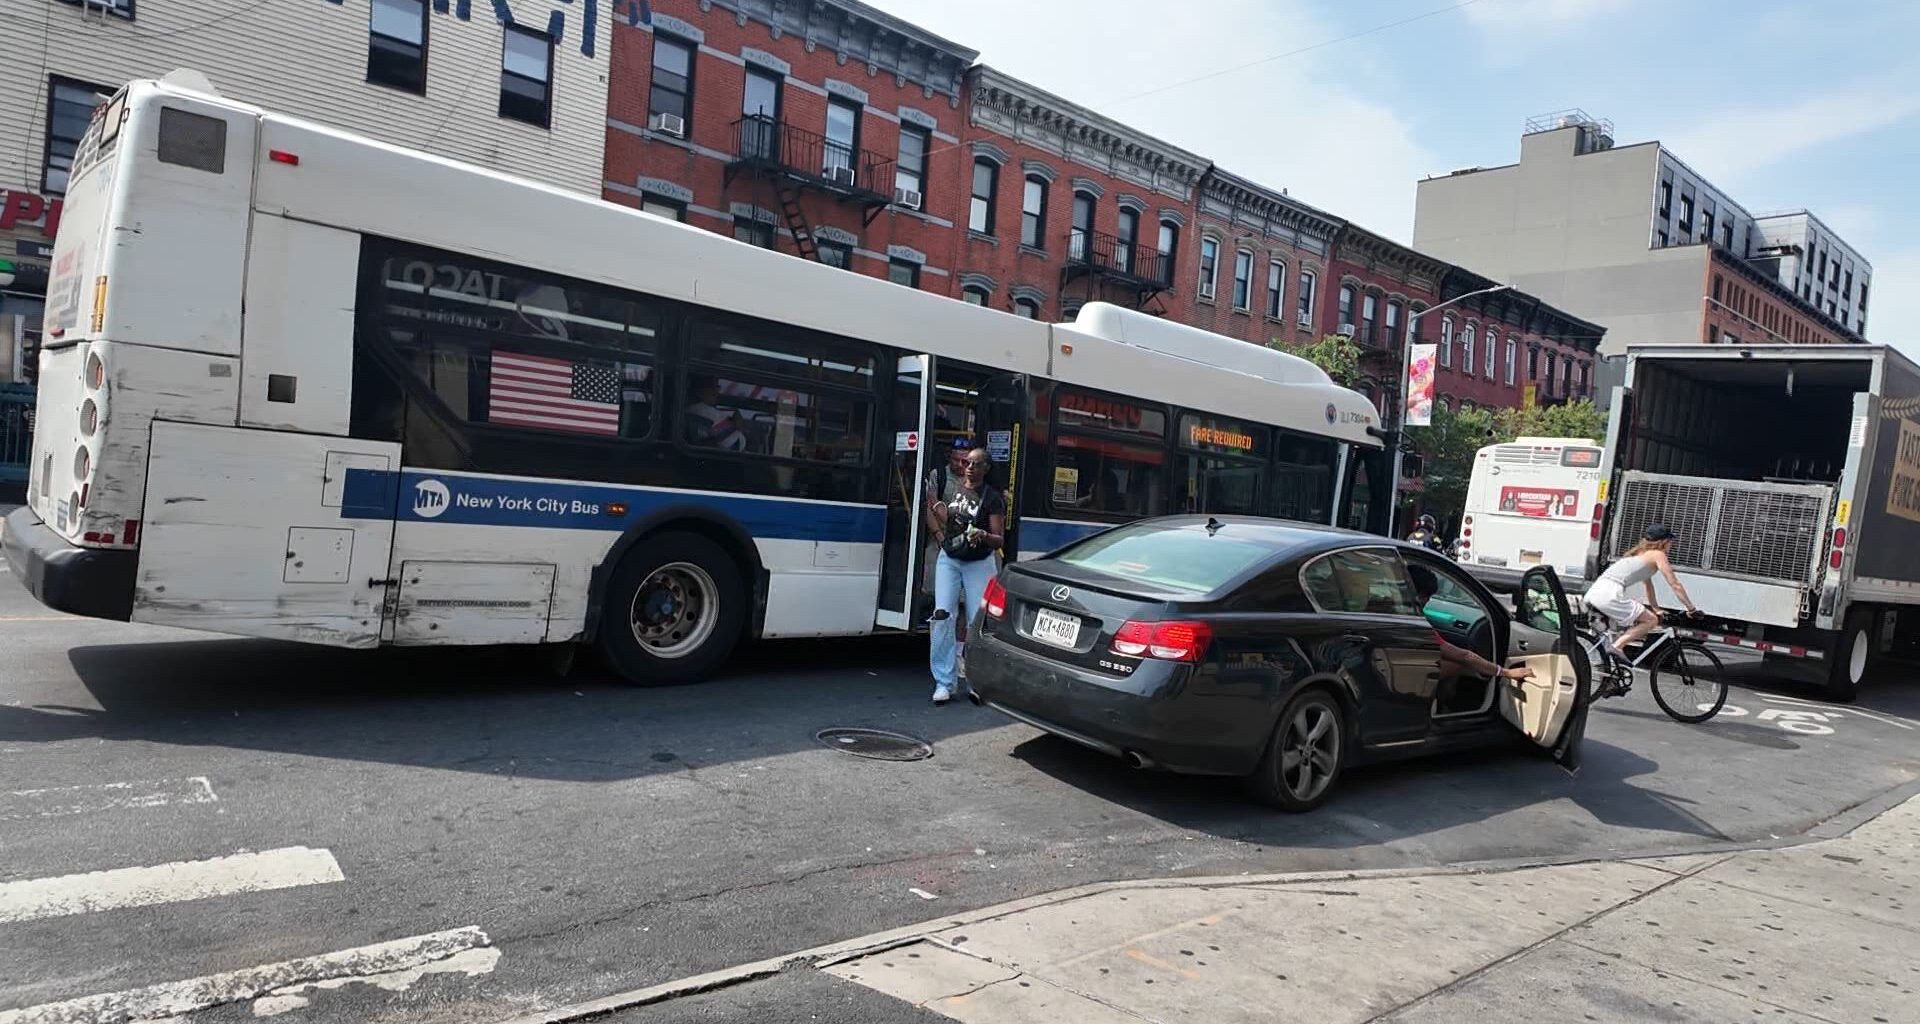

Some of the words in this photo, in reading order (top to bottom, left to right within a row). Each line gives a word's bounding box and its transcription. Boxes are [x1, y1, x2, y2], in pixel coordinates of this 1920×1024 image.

[1191, 425, 1212, 443] FARE
[1213, 430, 1252, 450] REQUIRED
[412, 483, 446, 513] MTA
[456, 492, 493, 509] New
[497, 495, 532, 511] York
[536, 498, 567, 515] City
[571, 501, 600, 515] Bus
